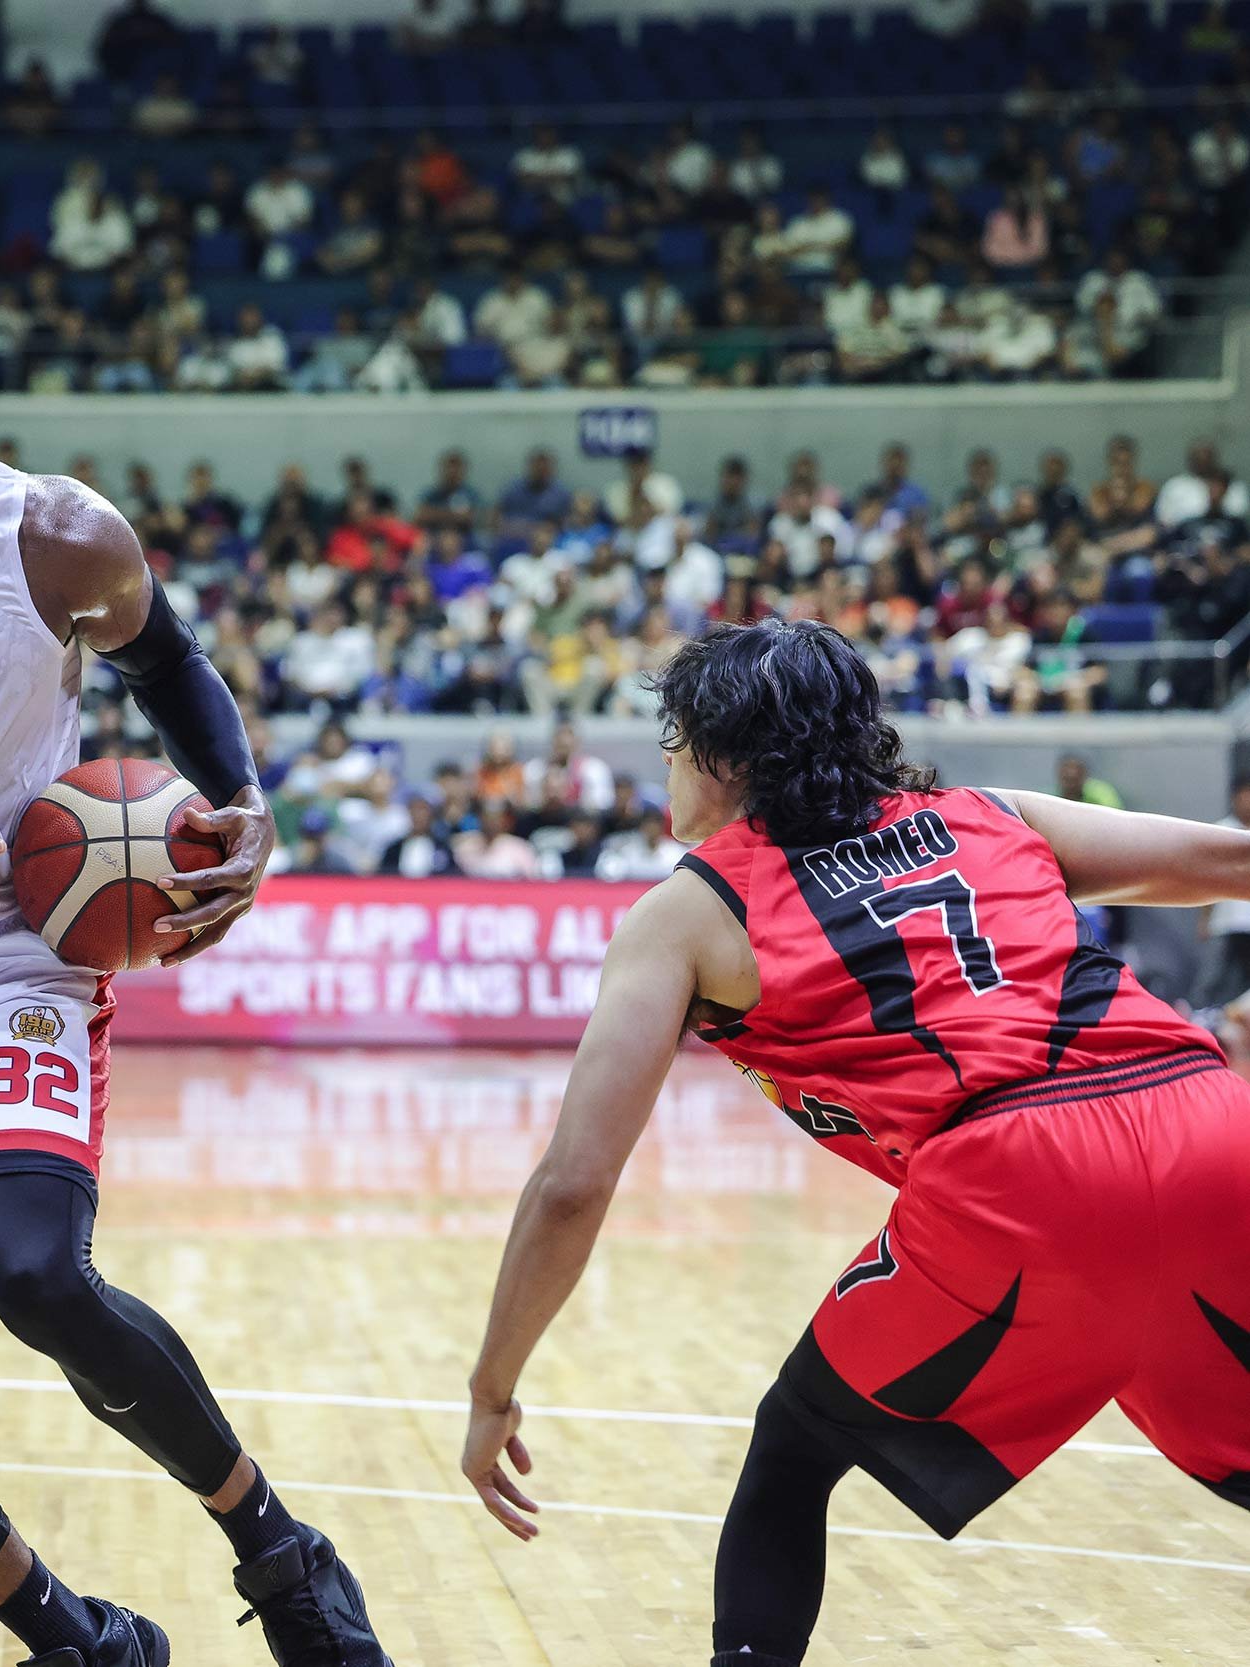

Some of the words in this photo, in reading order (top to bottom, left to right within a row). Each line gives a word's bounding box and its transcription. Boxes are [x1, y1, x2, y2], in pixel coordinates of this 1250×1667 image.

[802, 808, 959, 899] ROMEO
[439, 903, 539, 958] FOR
[547, 904, 630, 960] AL
[859, 868, 1014, 998] 7
[178, 960, 376, 1016] SPORTS
